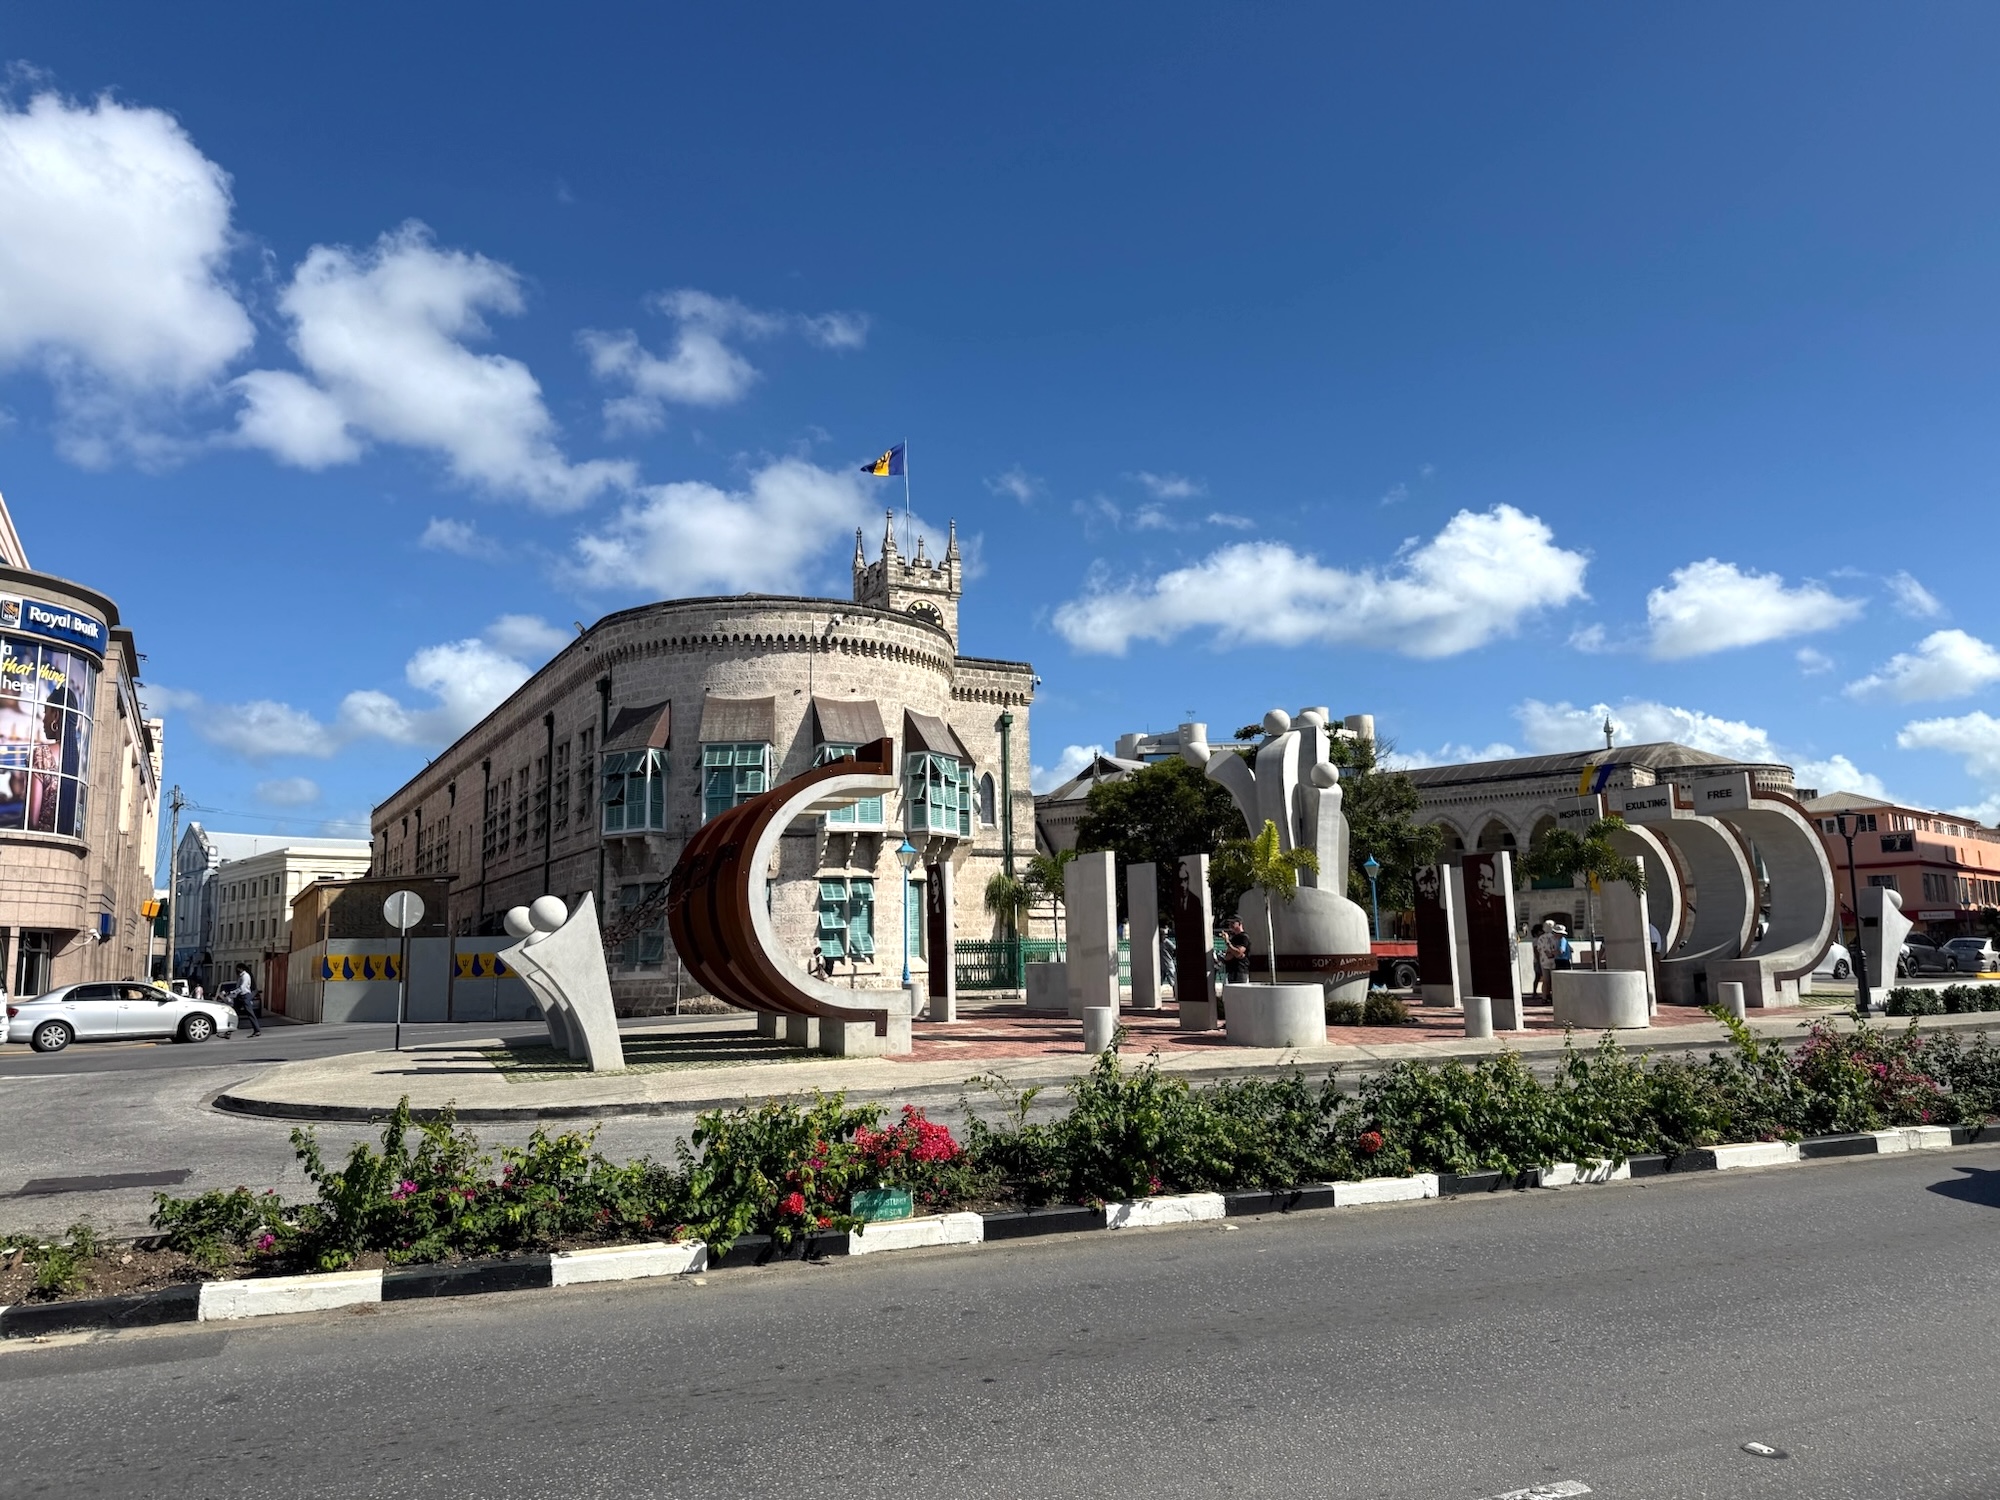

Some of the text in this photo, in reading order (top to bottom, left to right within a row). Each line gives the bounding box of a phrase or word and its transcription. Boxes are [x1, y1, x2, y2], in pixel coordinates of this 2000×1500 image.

[30, 606, 99, 638] Royal Bank
[2, 656, 66, 690] that thing
[3, 675, 34, 693] here
[1707, 789, 1732, 800] FREE
[1625, 798, 1667, 811] EXULTING
[1559, 807, 1595, 819] INSPIRED
